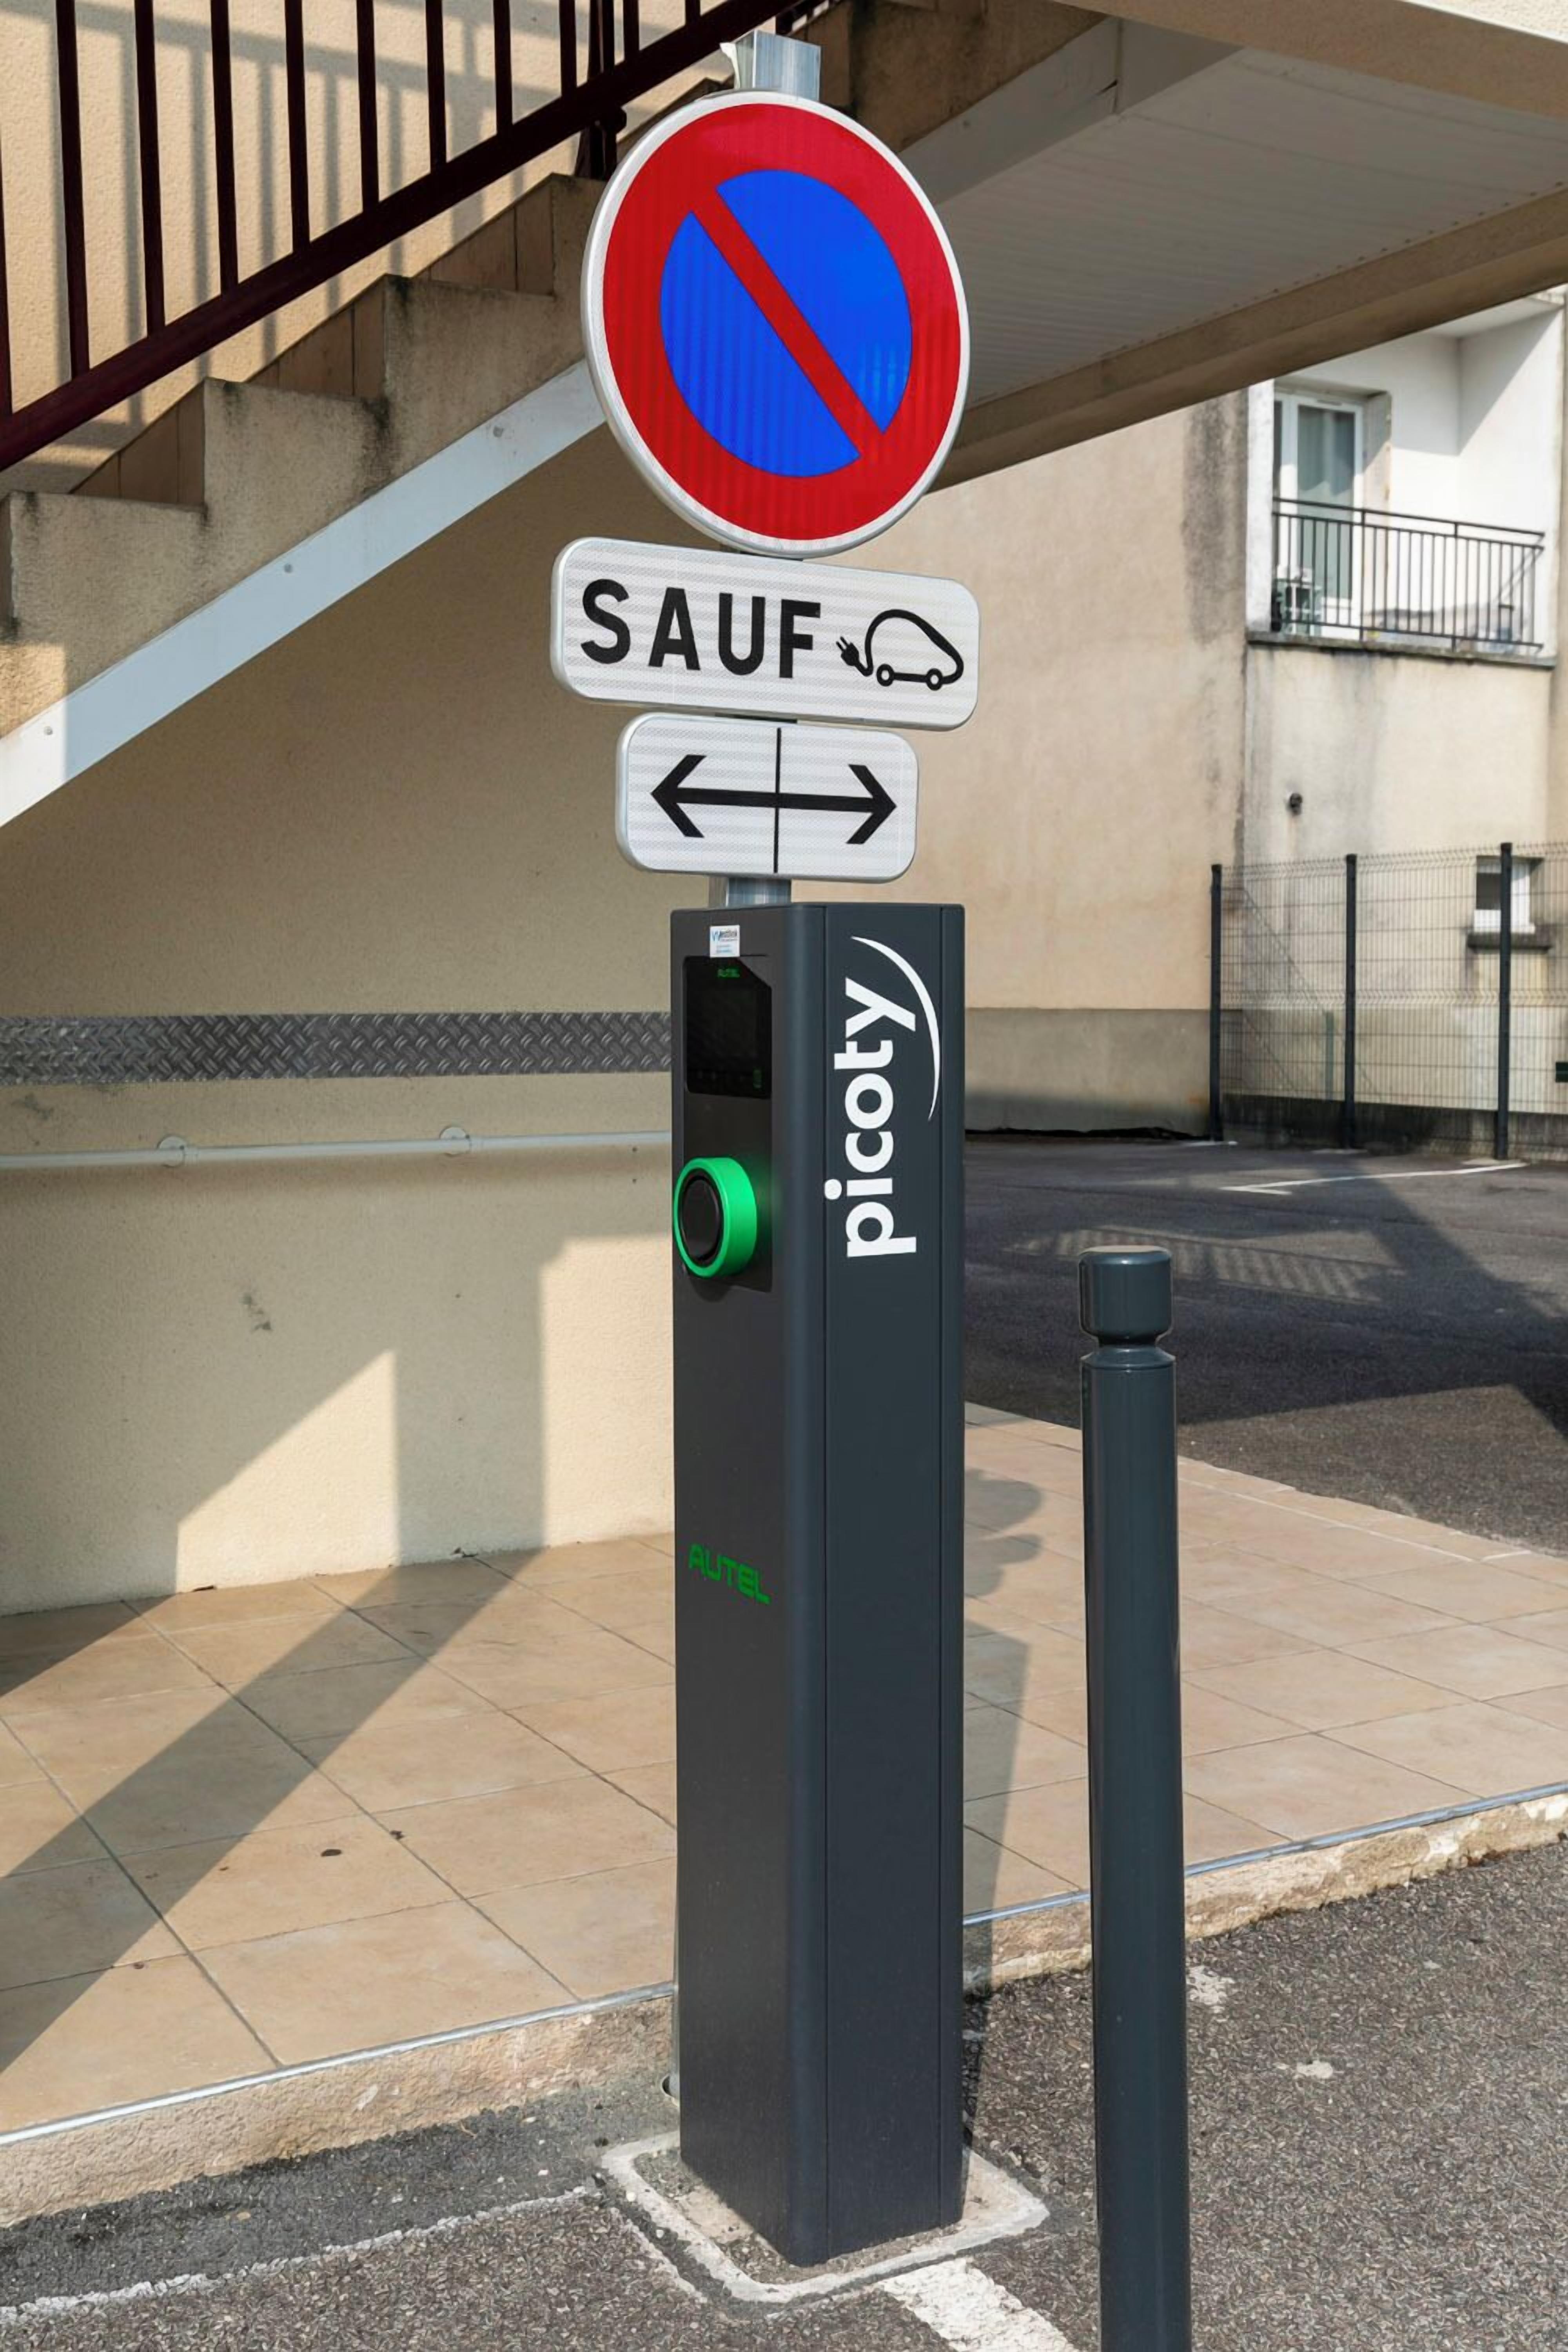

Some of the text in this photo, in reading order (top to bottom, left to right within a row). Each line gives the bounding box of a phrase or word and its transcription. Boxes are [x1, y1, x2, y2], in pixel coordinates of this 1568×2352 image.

[580, 579, 821, 679] SAUF
[824, 977, 917, 1258] picoty
[689, 1543, 771, 1604] AUTEL
